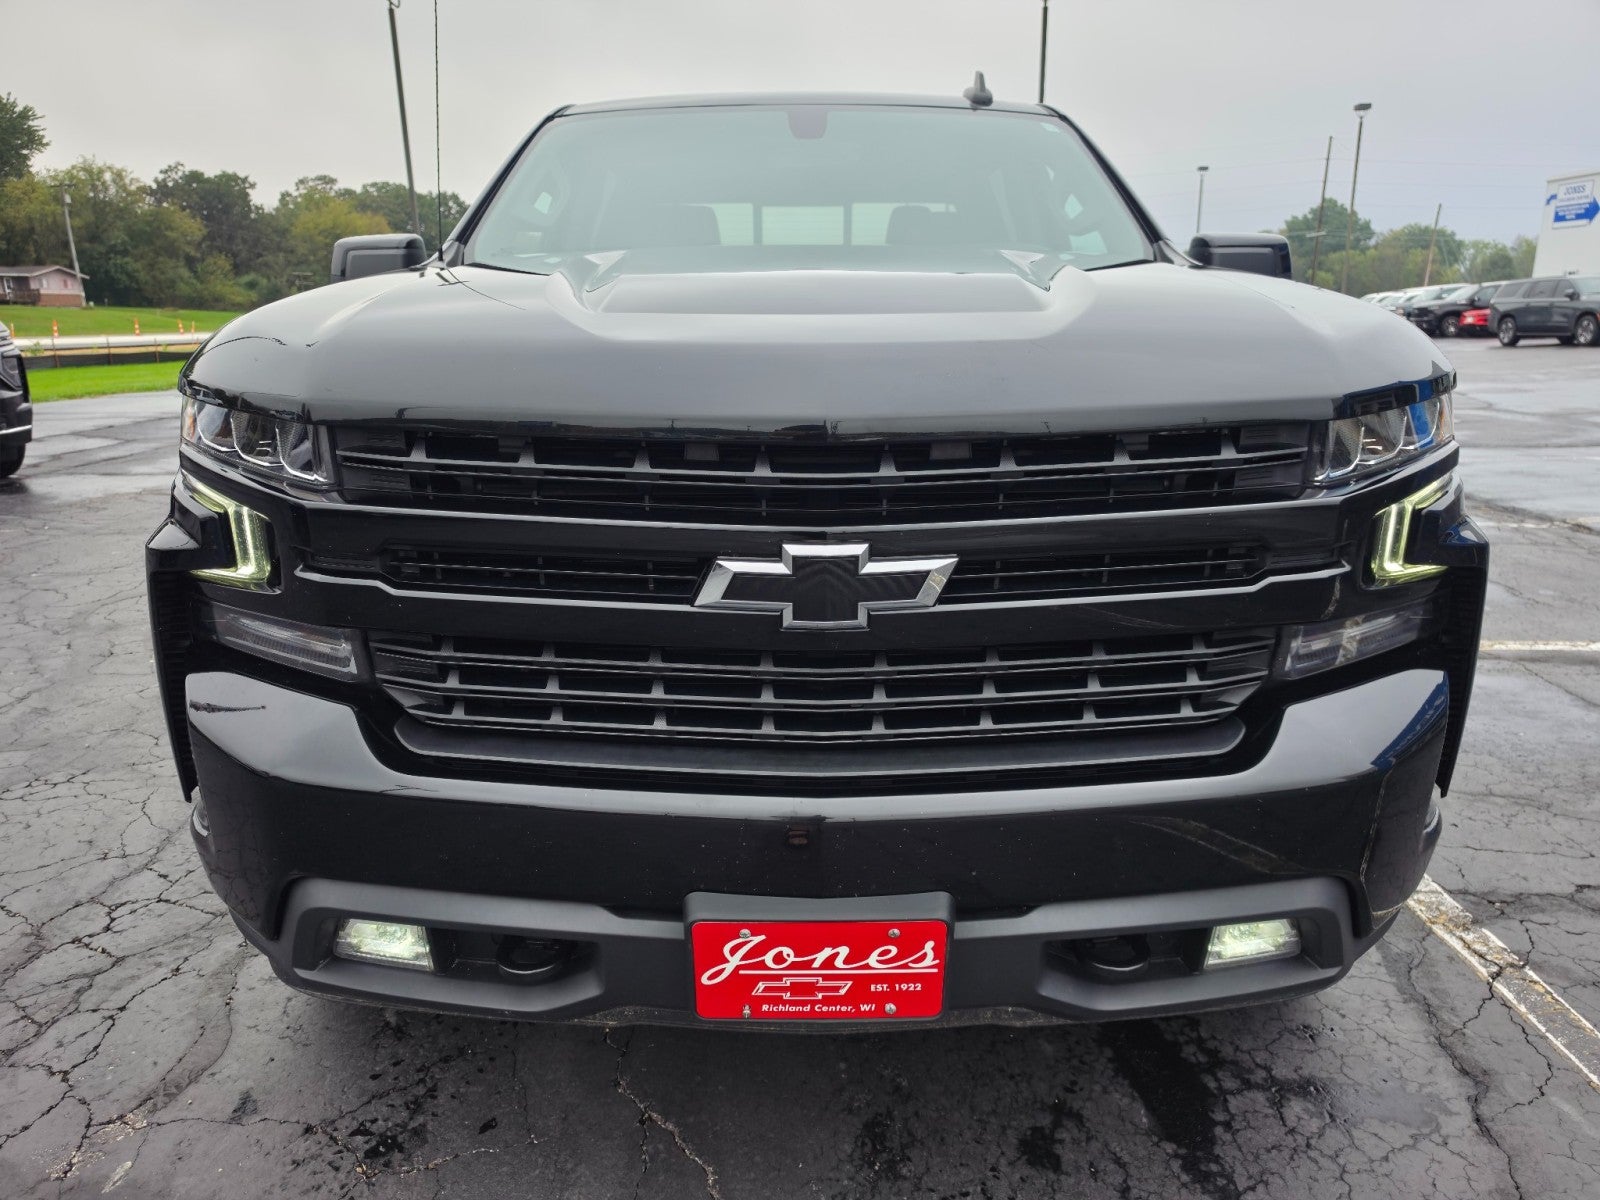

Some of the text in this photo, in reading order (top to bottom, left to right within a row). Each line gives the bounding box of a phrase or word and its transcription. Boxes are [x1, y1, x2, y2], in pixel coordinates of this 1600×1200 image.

[701, 935, 939, 985] Jones
[870, 983, 922, 992] EST. 1922
[761, 1003, 876, 1013] Richland Center, WI
